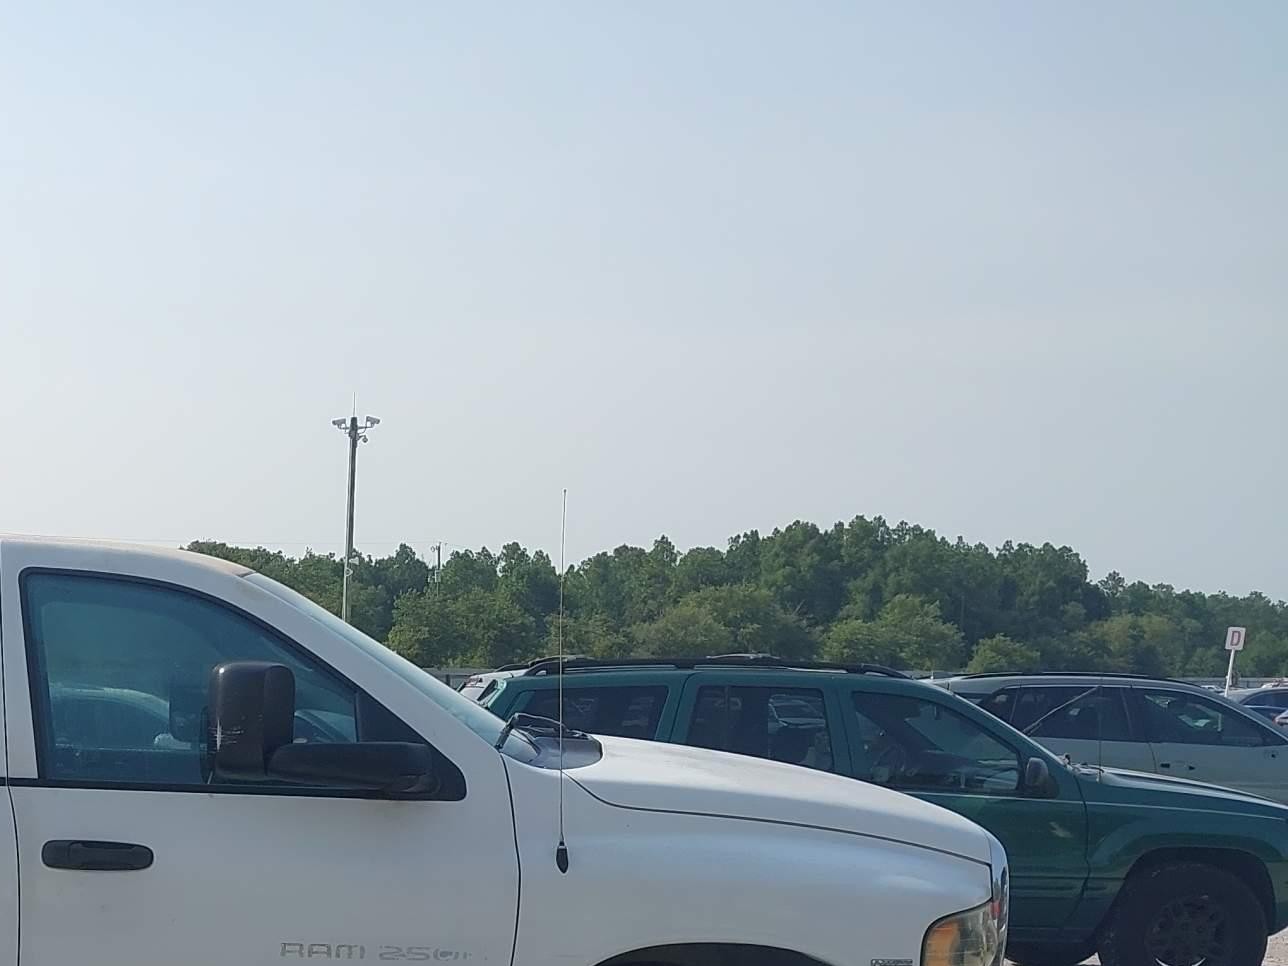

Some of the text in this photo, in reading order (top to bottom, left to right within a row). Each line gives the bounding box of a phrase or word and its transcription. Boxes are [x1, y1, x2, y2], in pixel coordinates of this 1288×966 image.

[1230, 630, 1241, 646] D
[280, 942, 489, 962] RAM 250
